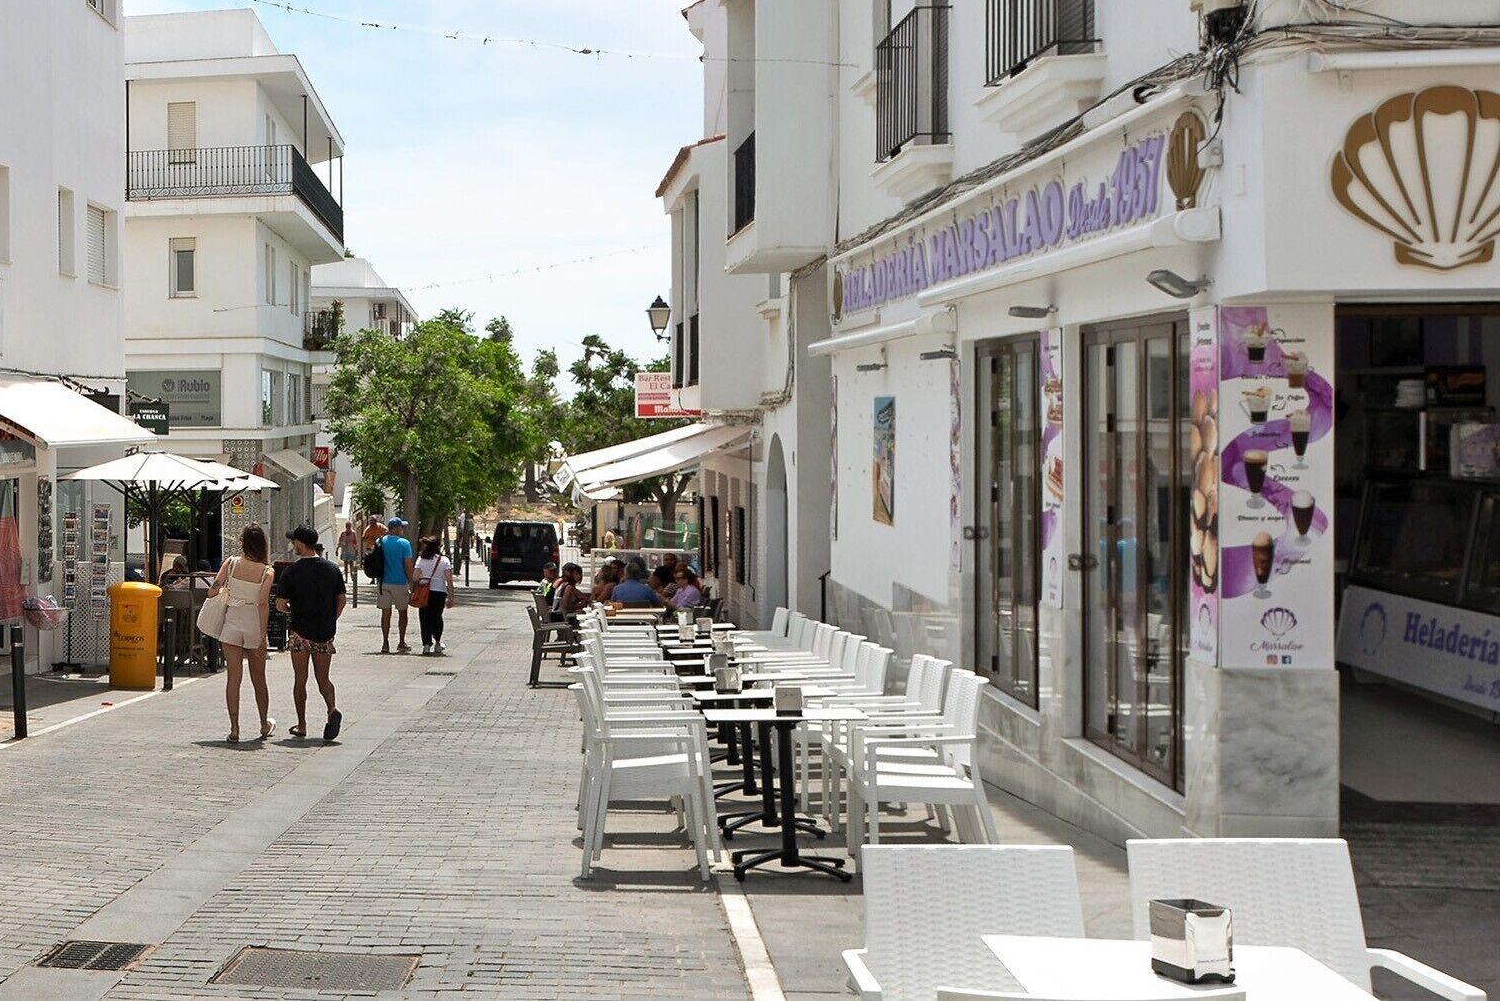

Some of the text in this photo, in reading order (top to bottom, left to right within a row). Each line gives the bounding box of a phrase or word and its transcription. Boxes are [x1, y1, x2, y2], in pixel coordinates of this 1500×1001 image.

[844, 134, 1167, 313] HELADERÍA MARSALAO Desde 1957
[1403, 611, 1500, 666] Heladería
